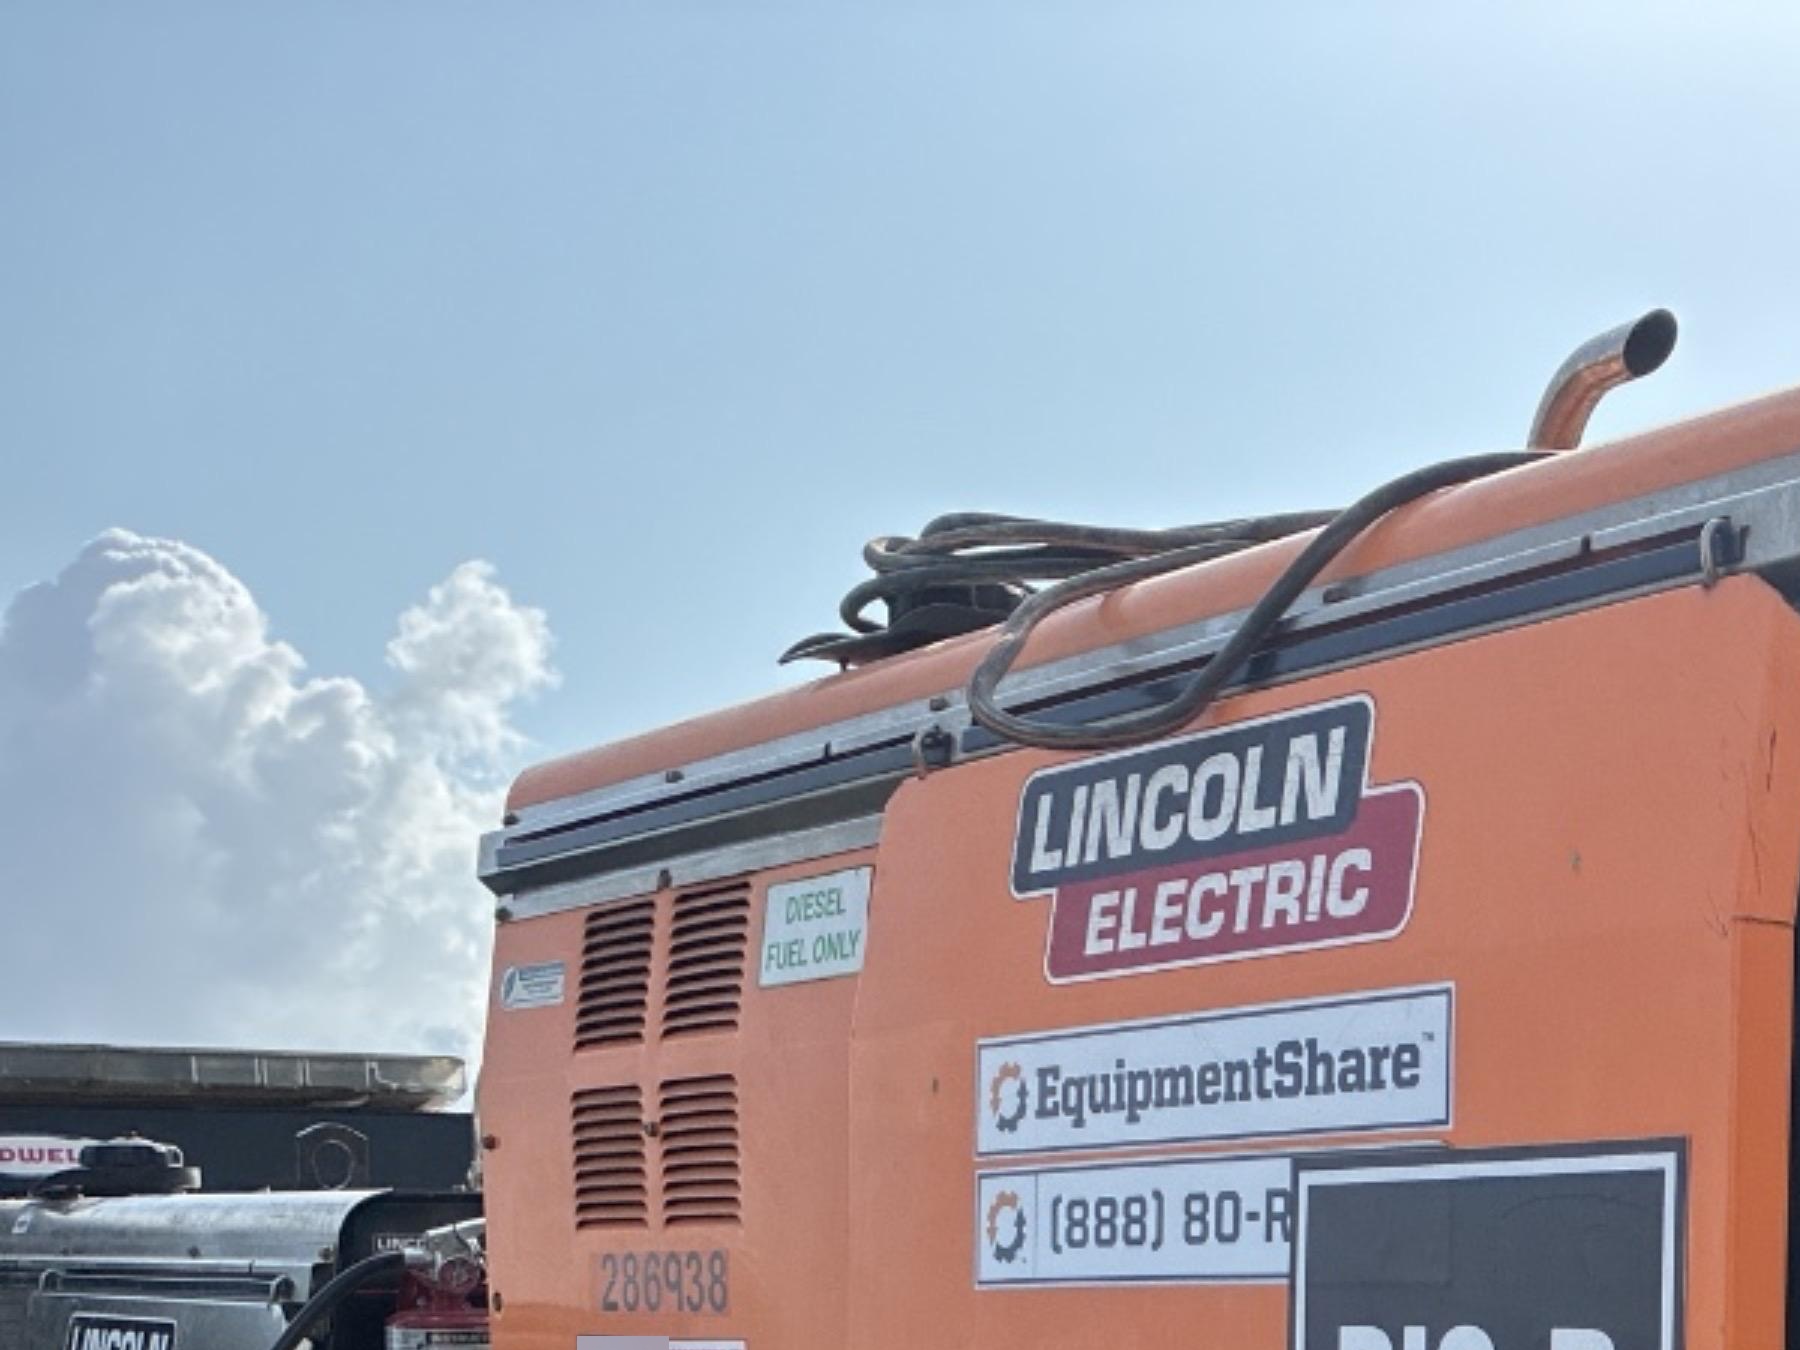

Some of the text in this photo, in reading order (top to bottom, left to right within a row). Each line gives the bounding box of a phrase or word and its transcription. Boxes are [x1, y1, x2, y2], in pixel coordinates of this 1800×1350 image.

[1030, 726, 1347, 874] LINCOLN
[785, 887, 847, 925] DIESEL
[1083, 848, 1373, 957] ELECTRIC
[765, 928, 861, 973] FUEL ONLY
[1034, 1037, 1421, 1128] EquipmentShare
[1051, 1188, 1164, 1254] (888)
[601, 1251, 728, 1313] 286938
